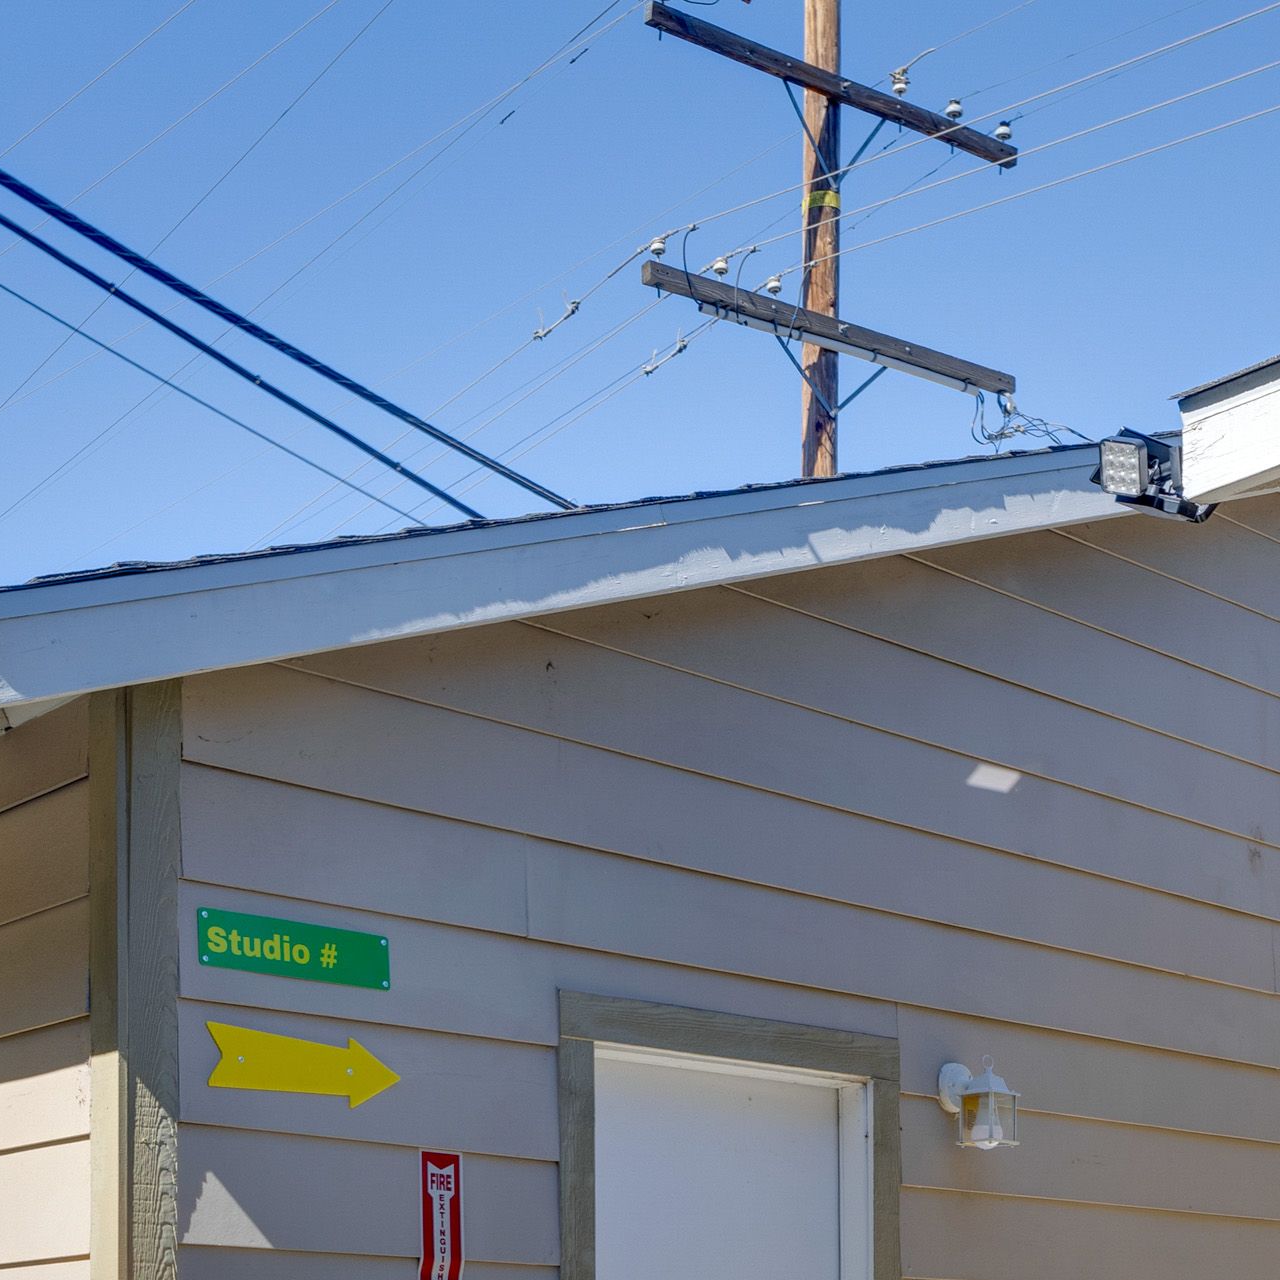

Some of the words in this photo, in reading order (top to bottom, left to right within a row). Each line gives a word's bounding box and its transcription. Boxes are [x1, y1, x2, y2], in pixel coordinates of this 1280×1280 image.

[207, 926, 311, 965] Studio
[320, 943, 337, 968] #
[430, 1173, 452, 1192] FIRE
